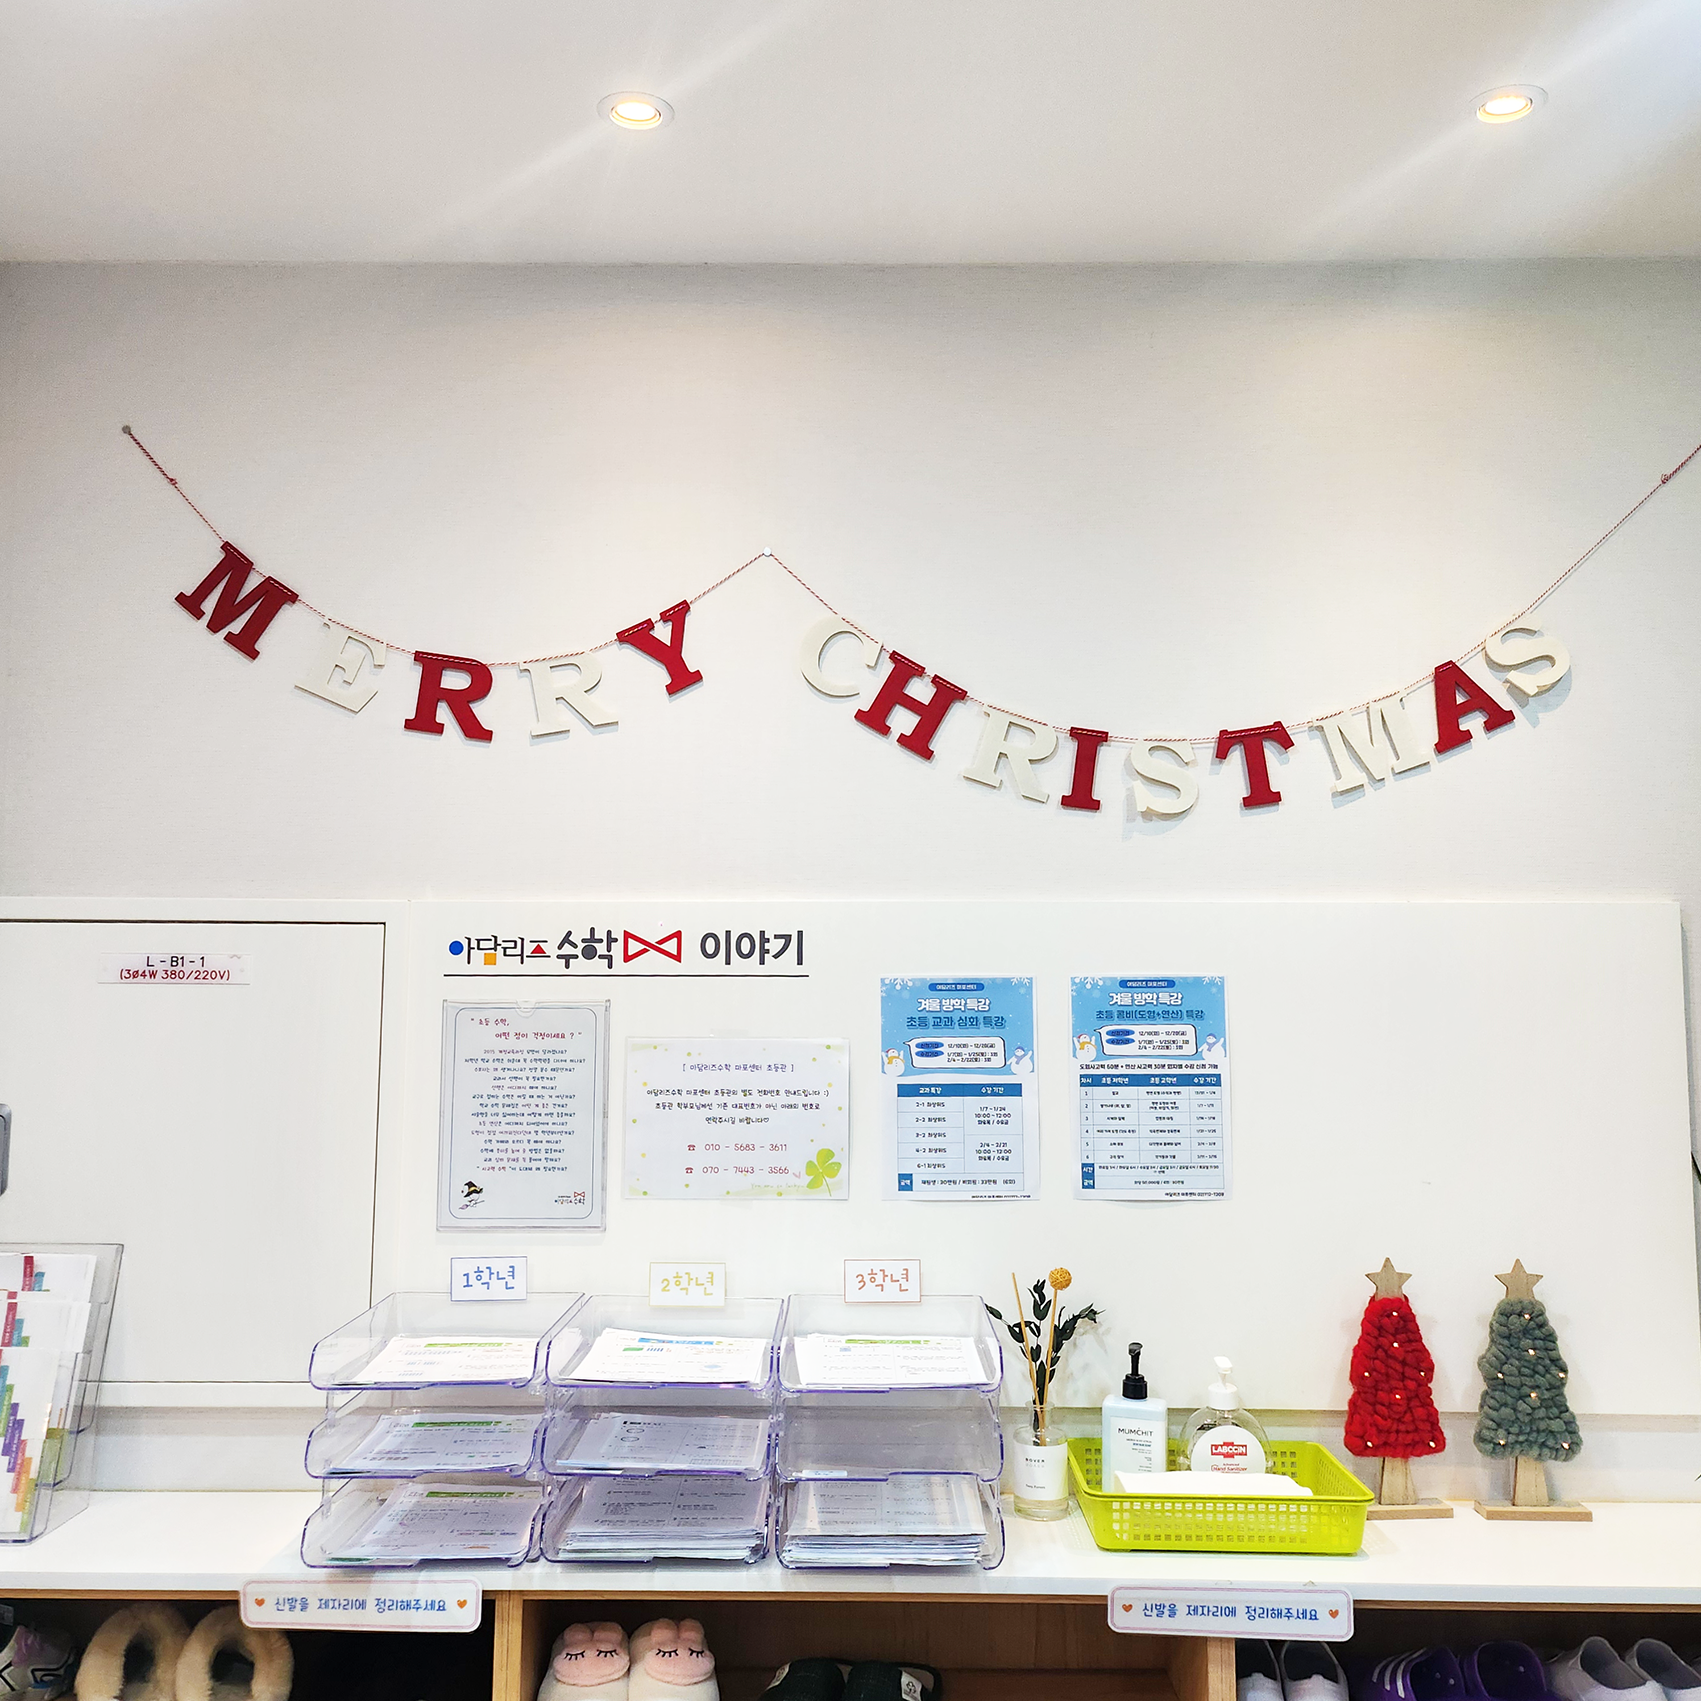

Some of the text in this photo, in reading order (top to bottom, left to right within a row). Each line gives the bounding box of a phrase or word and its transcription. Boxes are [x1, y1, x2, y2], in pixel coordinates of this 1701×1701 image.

[174, 541, 703, 742] MERRY
[799, 614, 1572, 816] CHRISTMAS
[700, 929, 804, 967] 이야기
[917, 997, 992, 1013] 겨울 방학 특강
[1108, 991, 1184, 1006] 겨울 방학 특강
[906, 1015, 1006, 1029] 초등 교과 심화 특강
[1095, 1009, 1114, 1020] 초등
[1185, 1009, 1206, 1020] 특강
[494, 1031, 566, 1041] 어떤 점이 걱정이세요
[734, 1063, 763, 1073] 마포센터
[766, 1063, 788, 1073] 초등관
[685, 1088, 711, 1098] 마포센터
[654, 1101, 674, 1111] 초등관
[704, 1143, 721, 1152] 010
[733, 1142, 756, 1152] 5683
[768, 1143, 788, 1152] 3611
[701, 1165, 720, 1174] 070
[732, 1165, 755, 1174] 7443
[767, 1165, 790, 1174] 3566
[462, 1264, 516, 1291] 1학년
[660, 1270, 715, 1297] 2학년
[855, 1267, 910, 1293] 3학년
[274, 1597, 447, 1614] 신발을 제자리에 정리해주세요
[1142, 1603, 1320, 1622] 신발을 제자리에 정리해주세요
